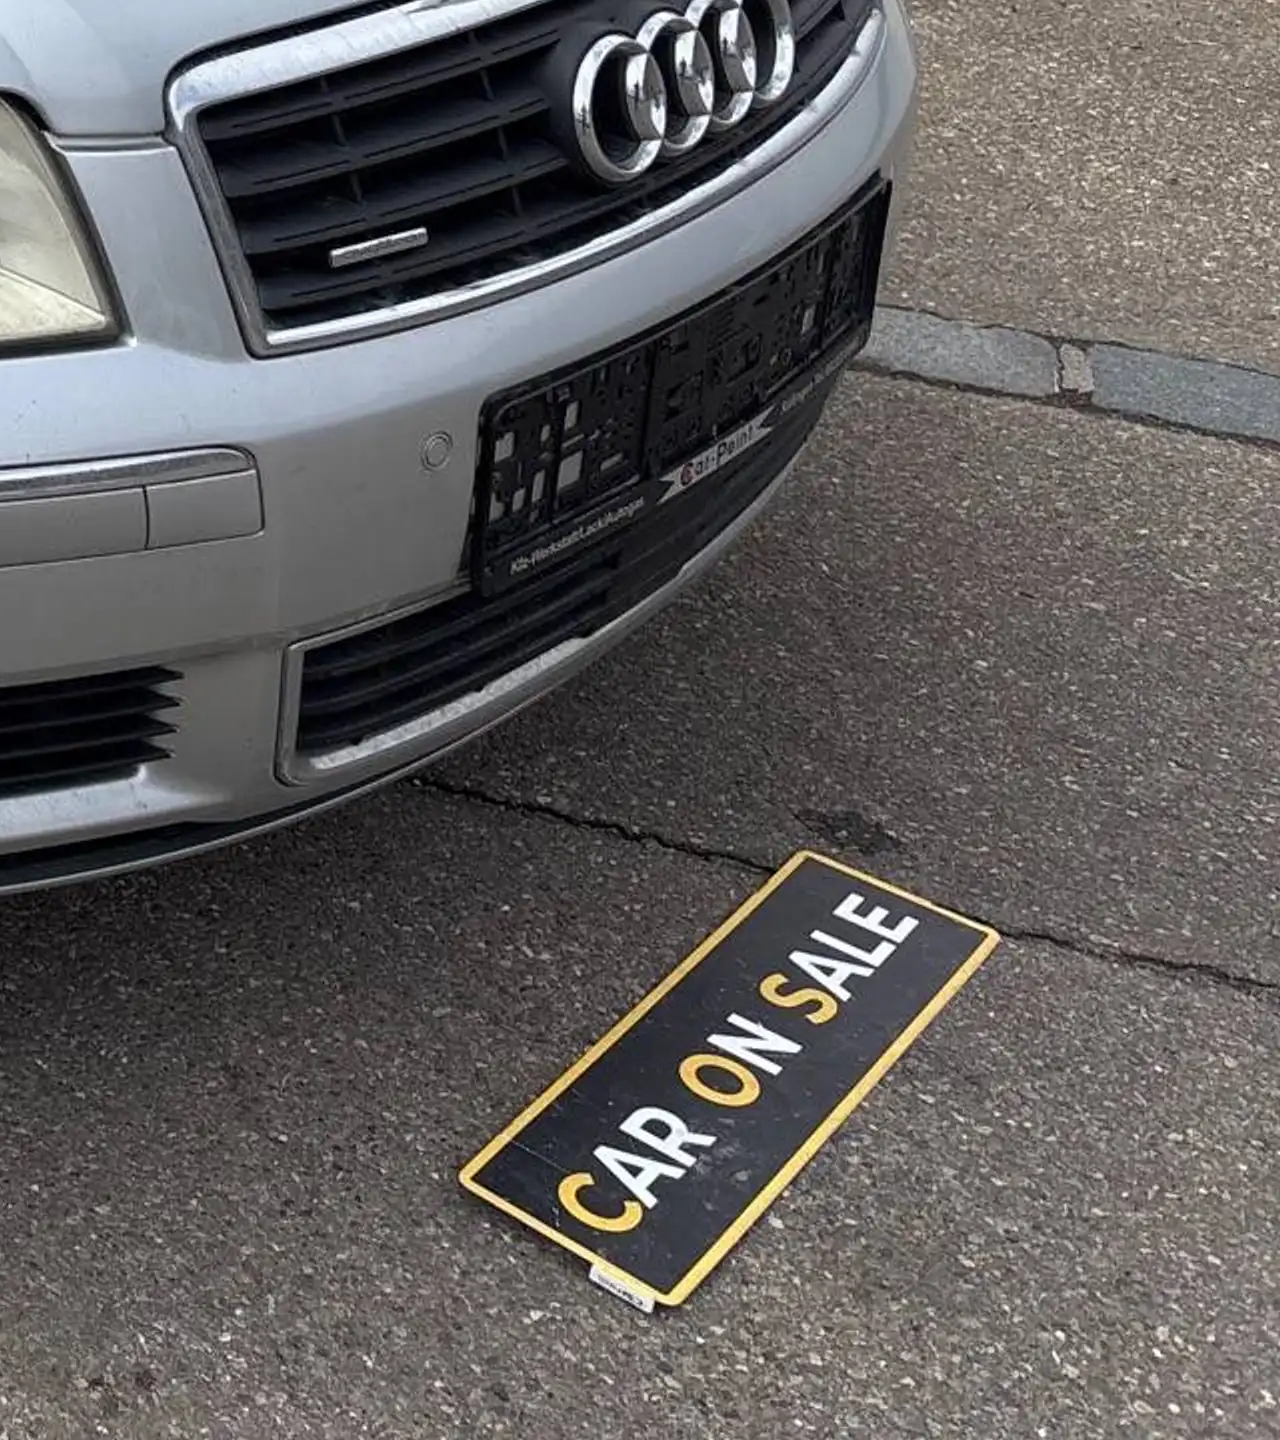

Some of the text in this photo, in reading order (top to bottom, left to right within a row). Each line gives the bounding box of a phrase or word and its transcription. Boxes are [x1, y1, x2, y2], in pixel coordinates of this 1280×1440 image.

[557, 892, 919, 1232] CAR ON SALE
